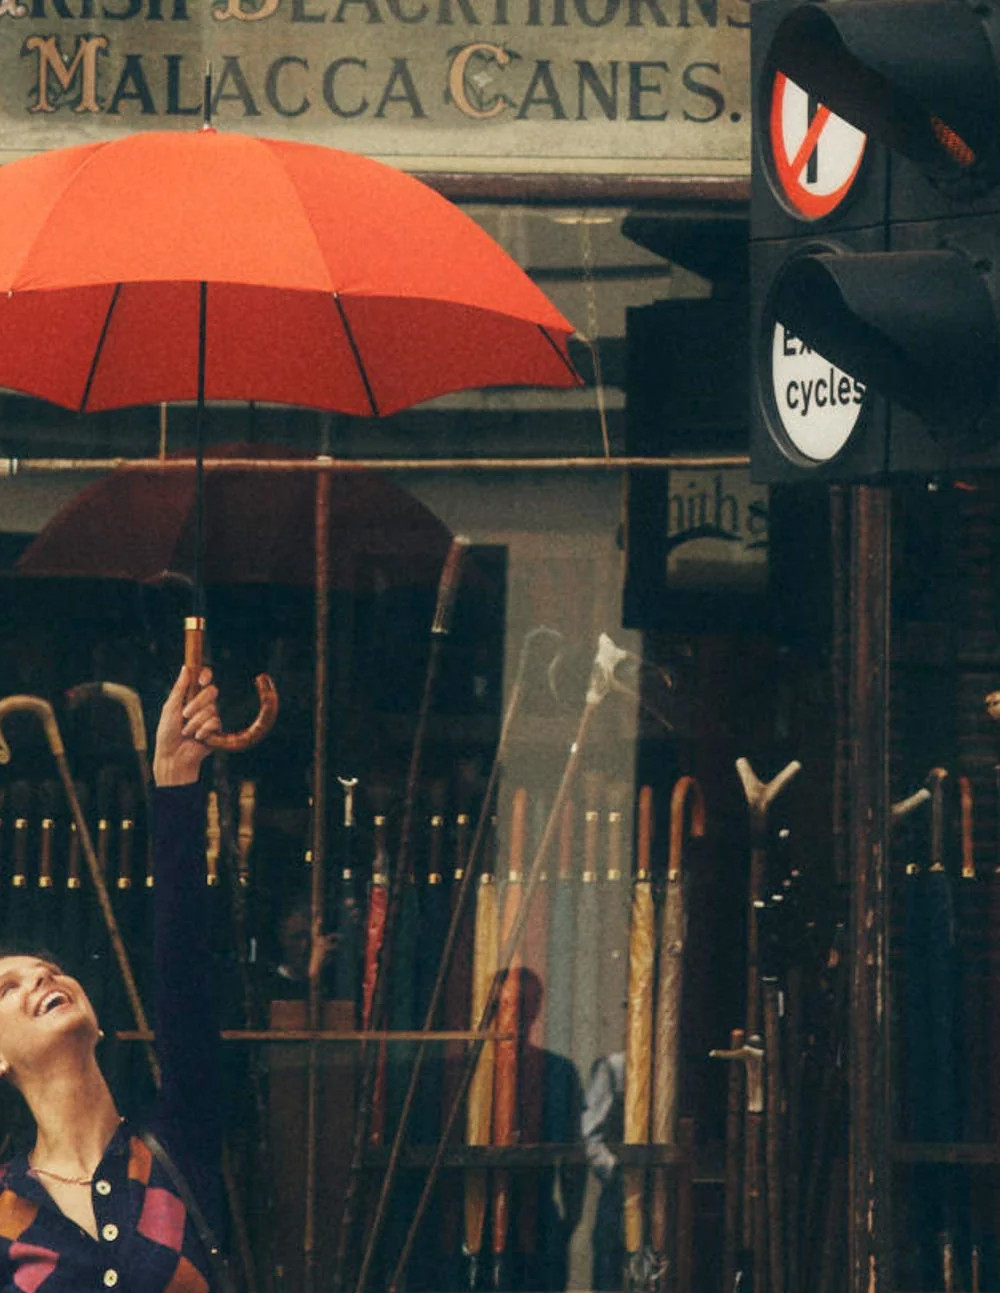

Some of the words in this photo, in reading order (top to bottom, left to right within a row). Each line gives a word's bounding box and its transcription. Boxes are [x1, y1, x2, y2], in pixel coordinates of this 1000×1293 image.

[21, 33, 430, 118] MALACCA
[447, 41, 742, 122] CANES.
[786, 367, 867, 416] cycles
